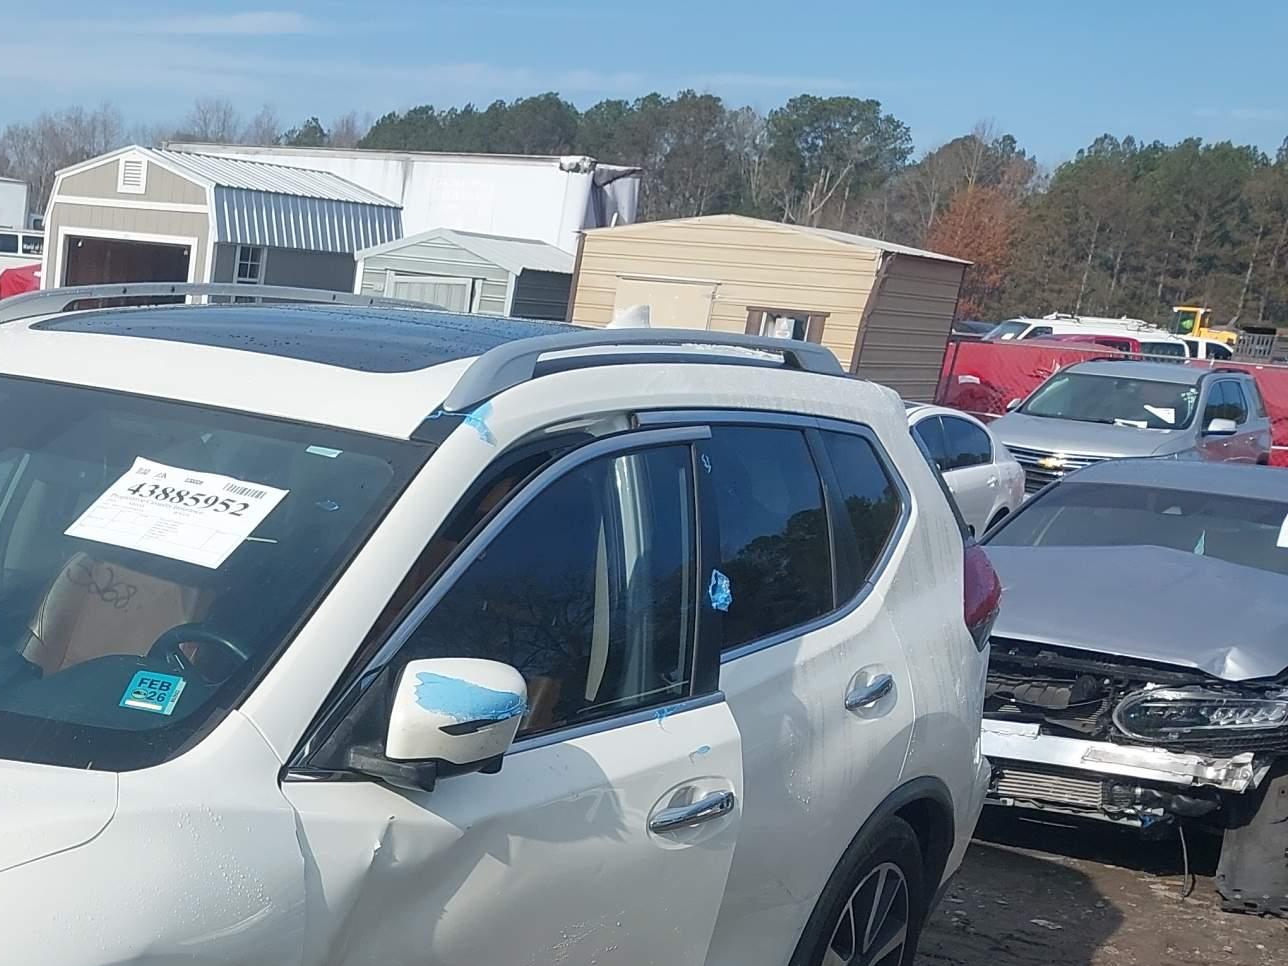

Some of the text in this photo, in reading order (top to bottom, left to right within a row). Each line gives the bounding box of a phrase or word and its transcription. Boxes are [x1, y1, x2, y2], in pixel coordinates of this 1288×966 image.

[127, 482, 250, 517] 43885952
[138, 677, 172, 692] FEB
[146, 690, 167, 702] 26
